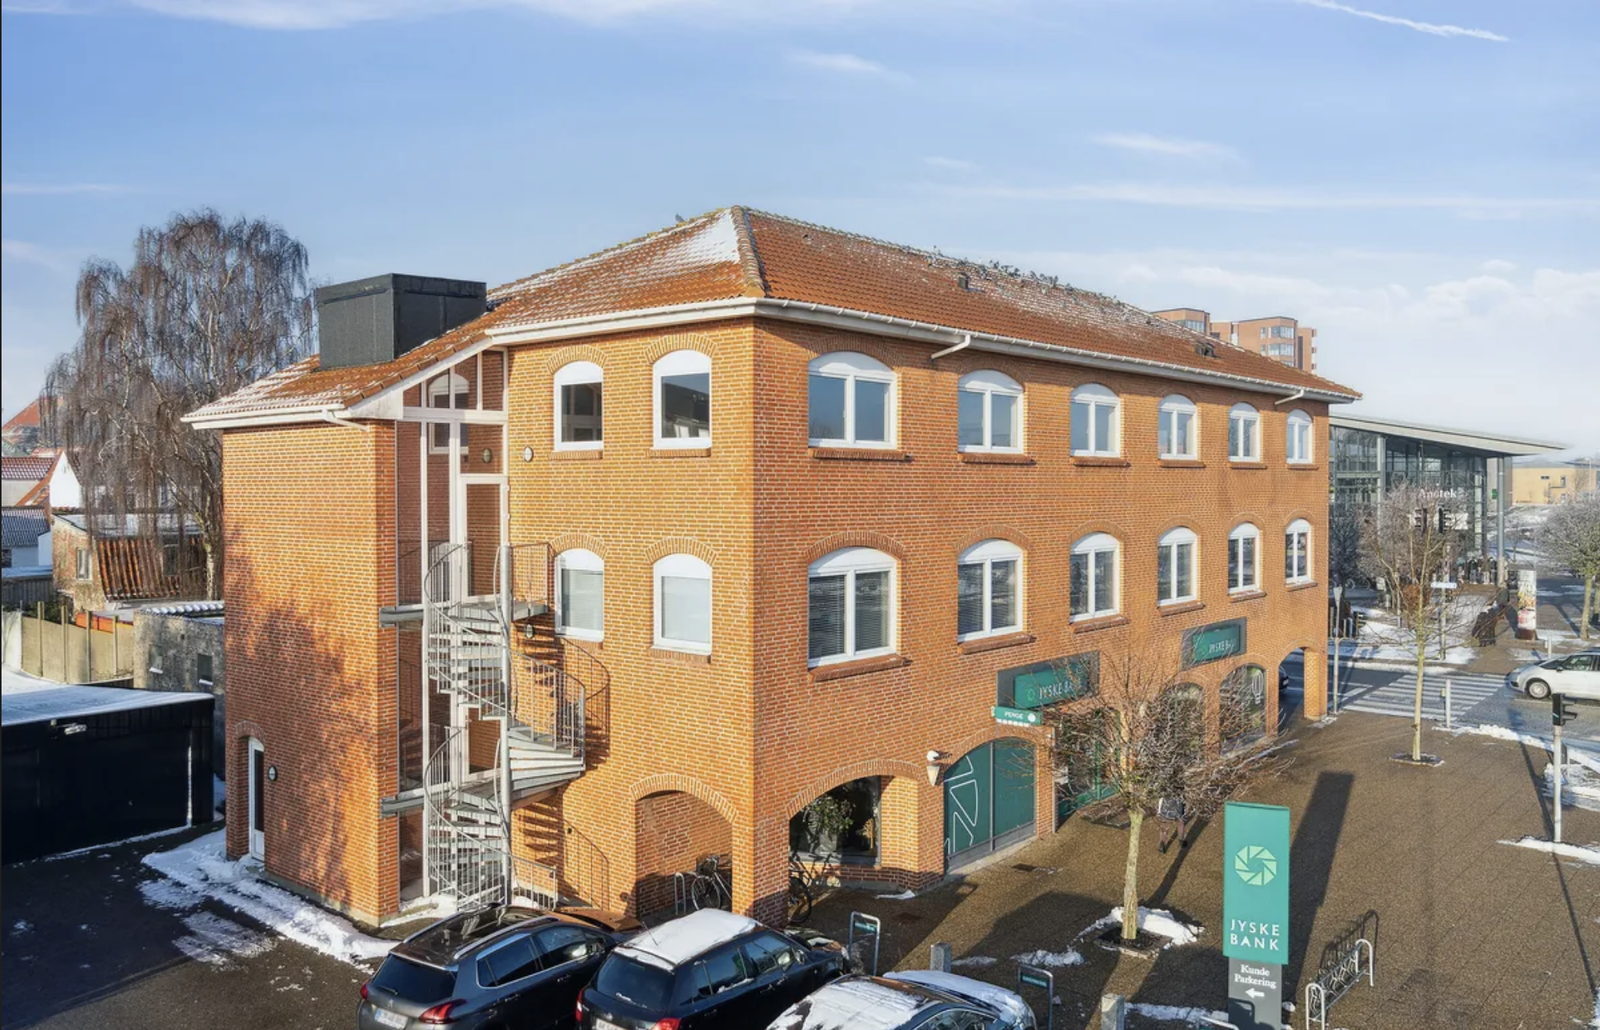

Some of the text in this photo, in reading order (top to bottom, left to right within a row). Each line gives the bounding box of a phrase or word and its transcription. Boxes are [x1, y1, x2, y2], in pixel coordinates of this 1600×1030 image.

[1039, 682, 1062, 699] JYSKE
[1230, 919, 1280, 936] JYSKE
[1230, 933, 1279, 951] BANK
[1240, 964, 1270, 977] Kunde
[1234, 973, 1277, 989] Parkering
